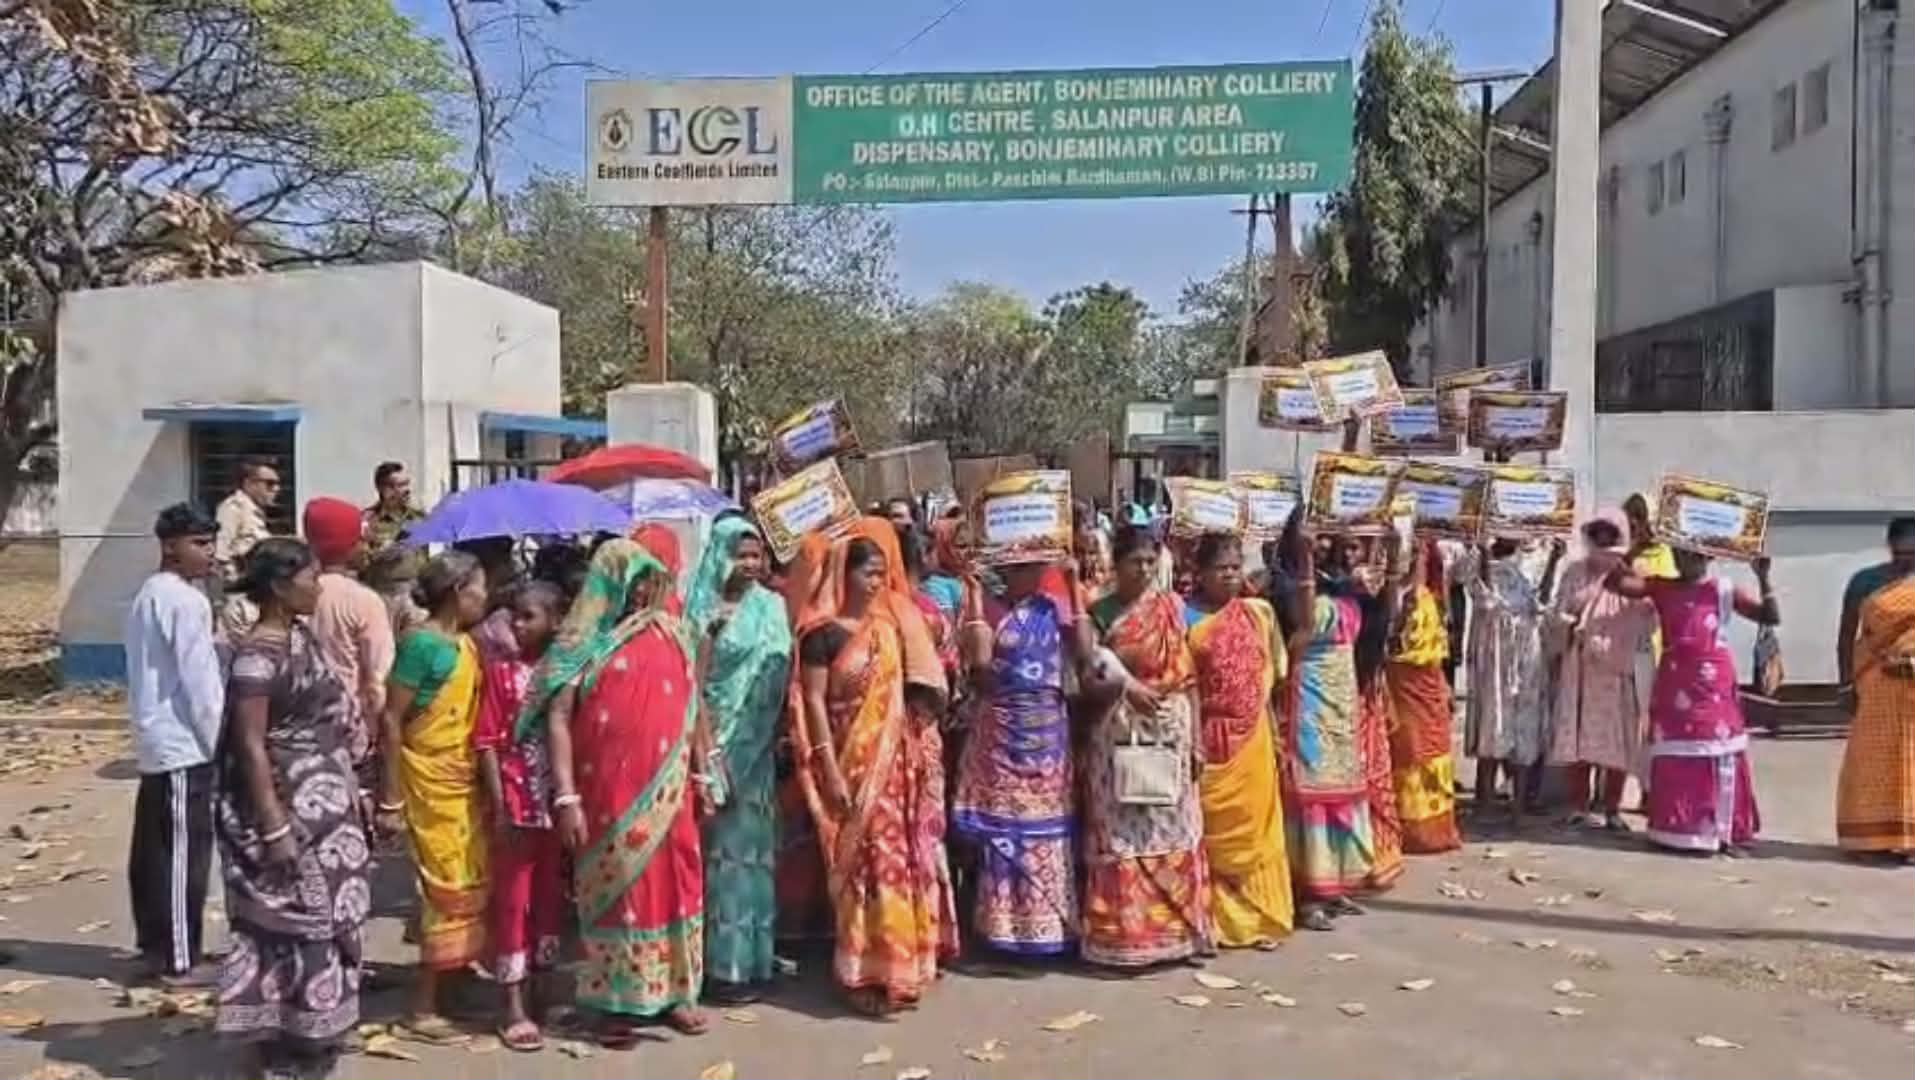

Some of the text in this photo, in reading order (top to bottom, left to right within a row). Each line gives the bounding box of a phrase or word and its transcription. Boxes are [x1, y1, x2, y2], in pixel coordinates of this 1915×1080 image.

[806, 71, 1337, 107] OFFICE OF THE AGENT, BONJEMIHARY COLLIERY
[948, 111, 1034, 133] CENTRE
[1052, 106, 1175, 130] SALANPUR
[1180, 103, 1243, 127] AREA
[853, 131, 1286, 165] DISPENSARY, BONJEMIHARY COLLIERY
[598, 159, 778, 180] Eastern Coalfields Limited
